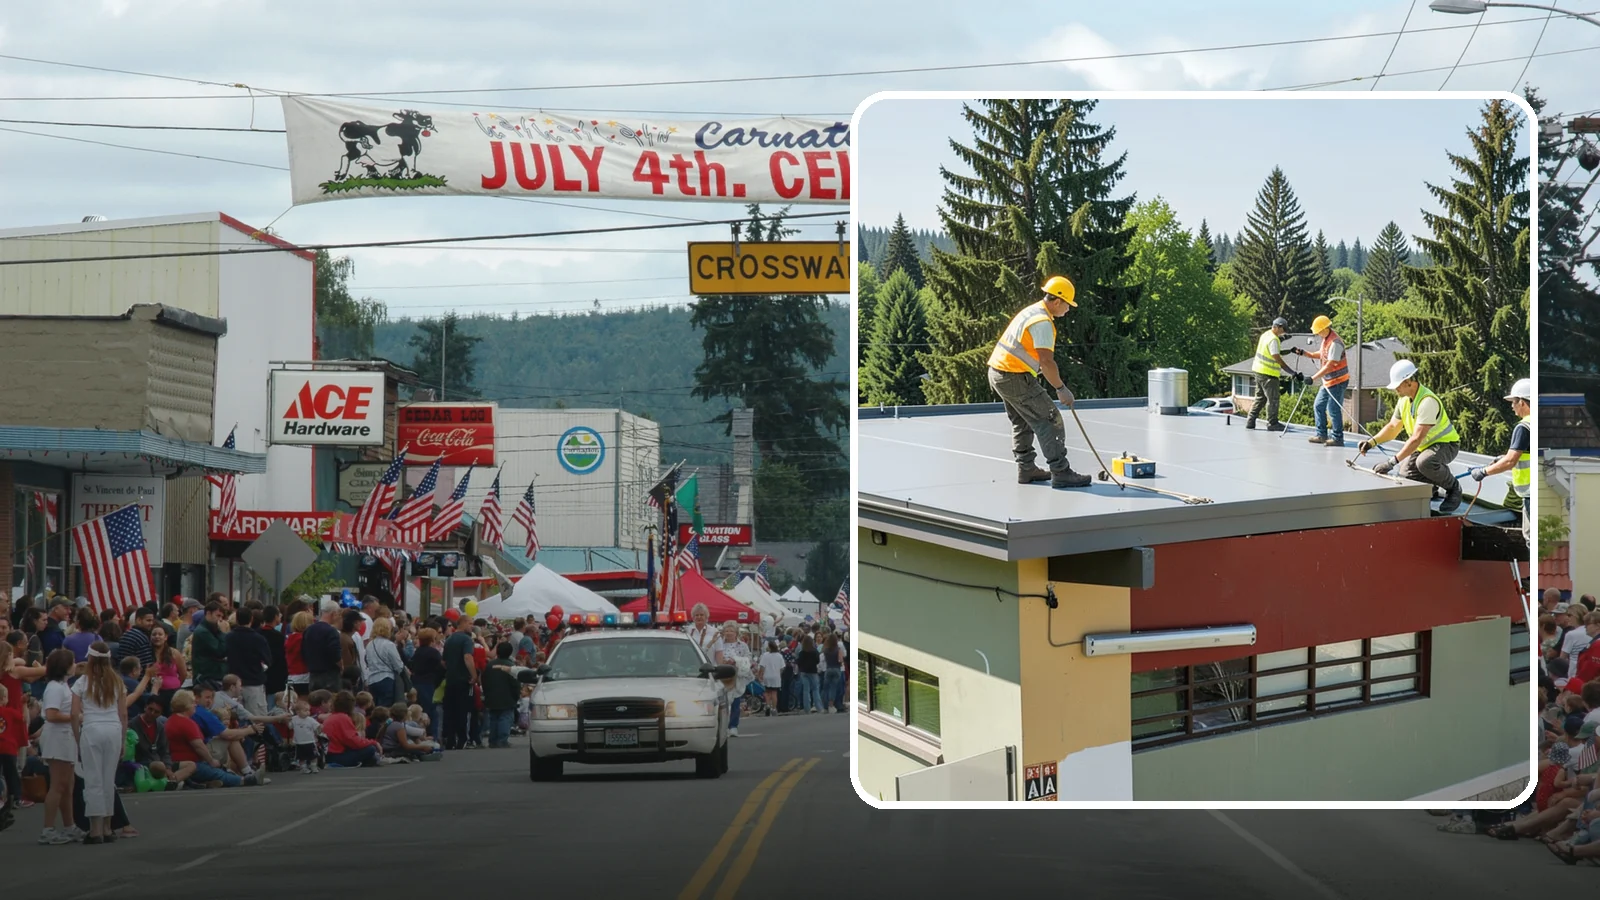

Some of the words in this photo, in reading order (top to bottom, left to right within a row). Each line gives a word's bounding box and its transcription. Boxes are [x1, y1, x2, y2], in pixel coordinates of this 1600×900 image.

[481, 141, 605, 192] JULY
[632, 150, 746, 197] 4th.
[696, 254, 850, 280] CROSSWA
[283, 380, 373, 420] ACE
[284, 421, 370, 436] Hardware
[416, 428, 477, 447] Coca-Cola
[353, 467, 385, 481] Simpl
[95, 486, 124, 495] Vincent
[126, 487, 136, 495] de
[138, 486, 155, 495] Paul
[688, 526, 742, 535] CRNATION
[699, 535, 731, 544] GLASS
